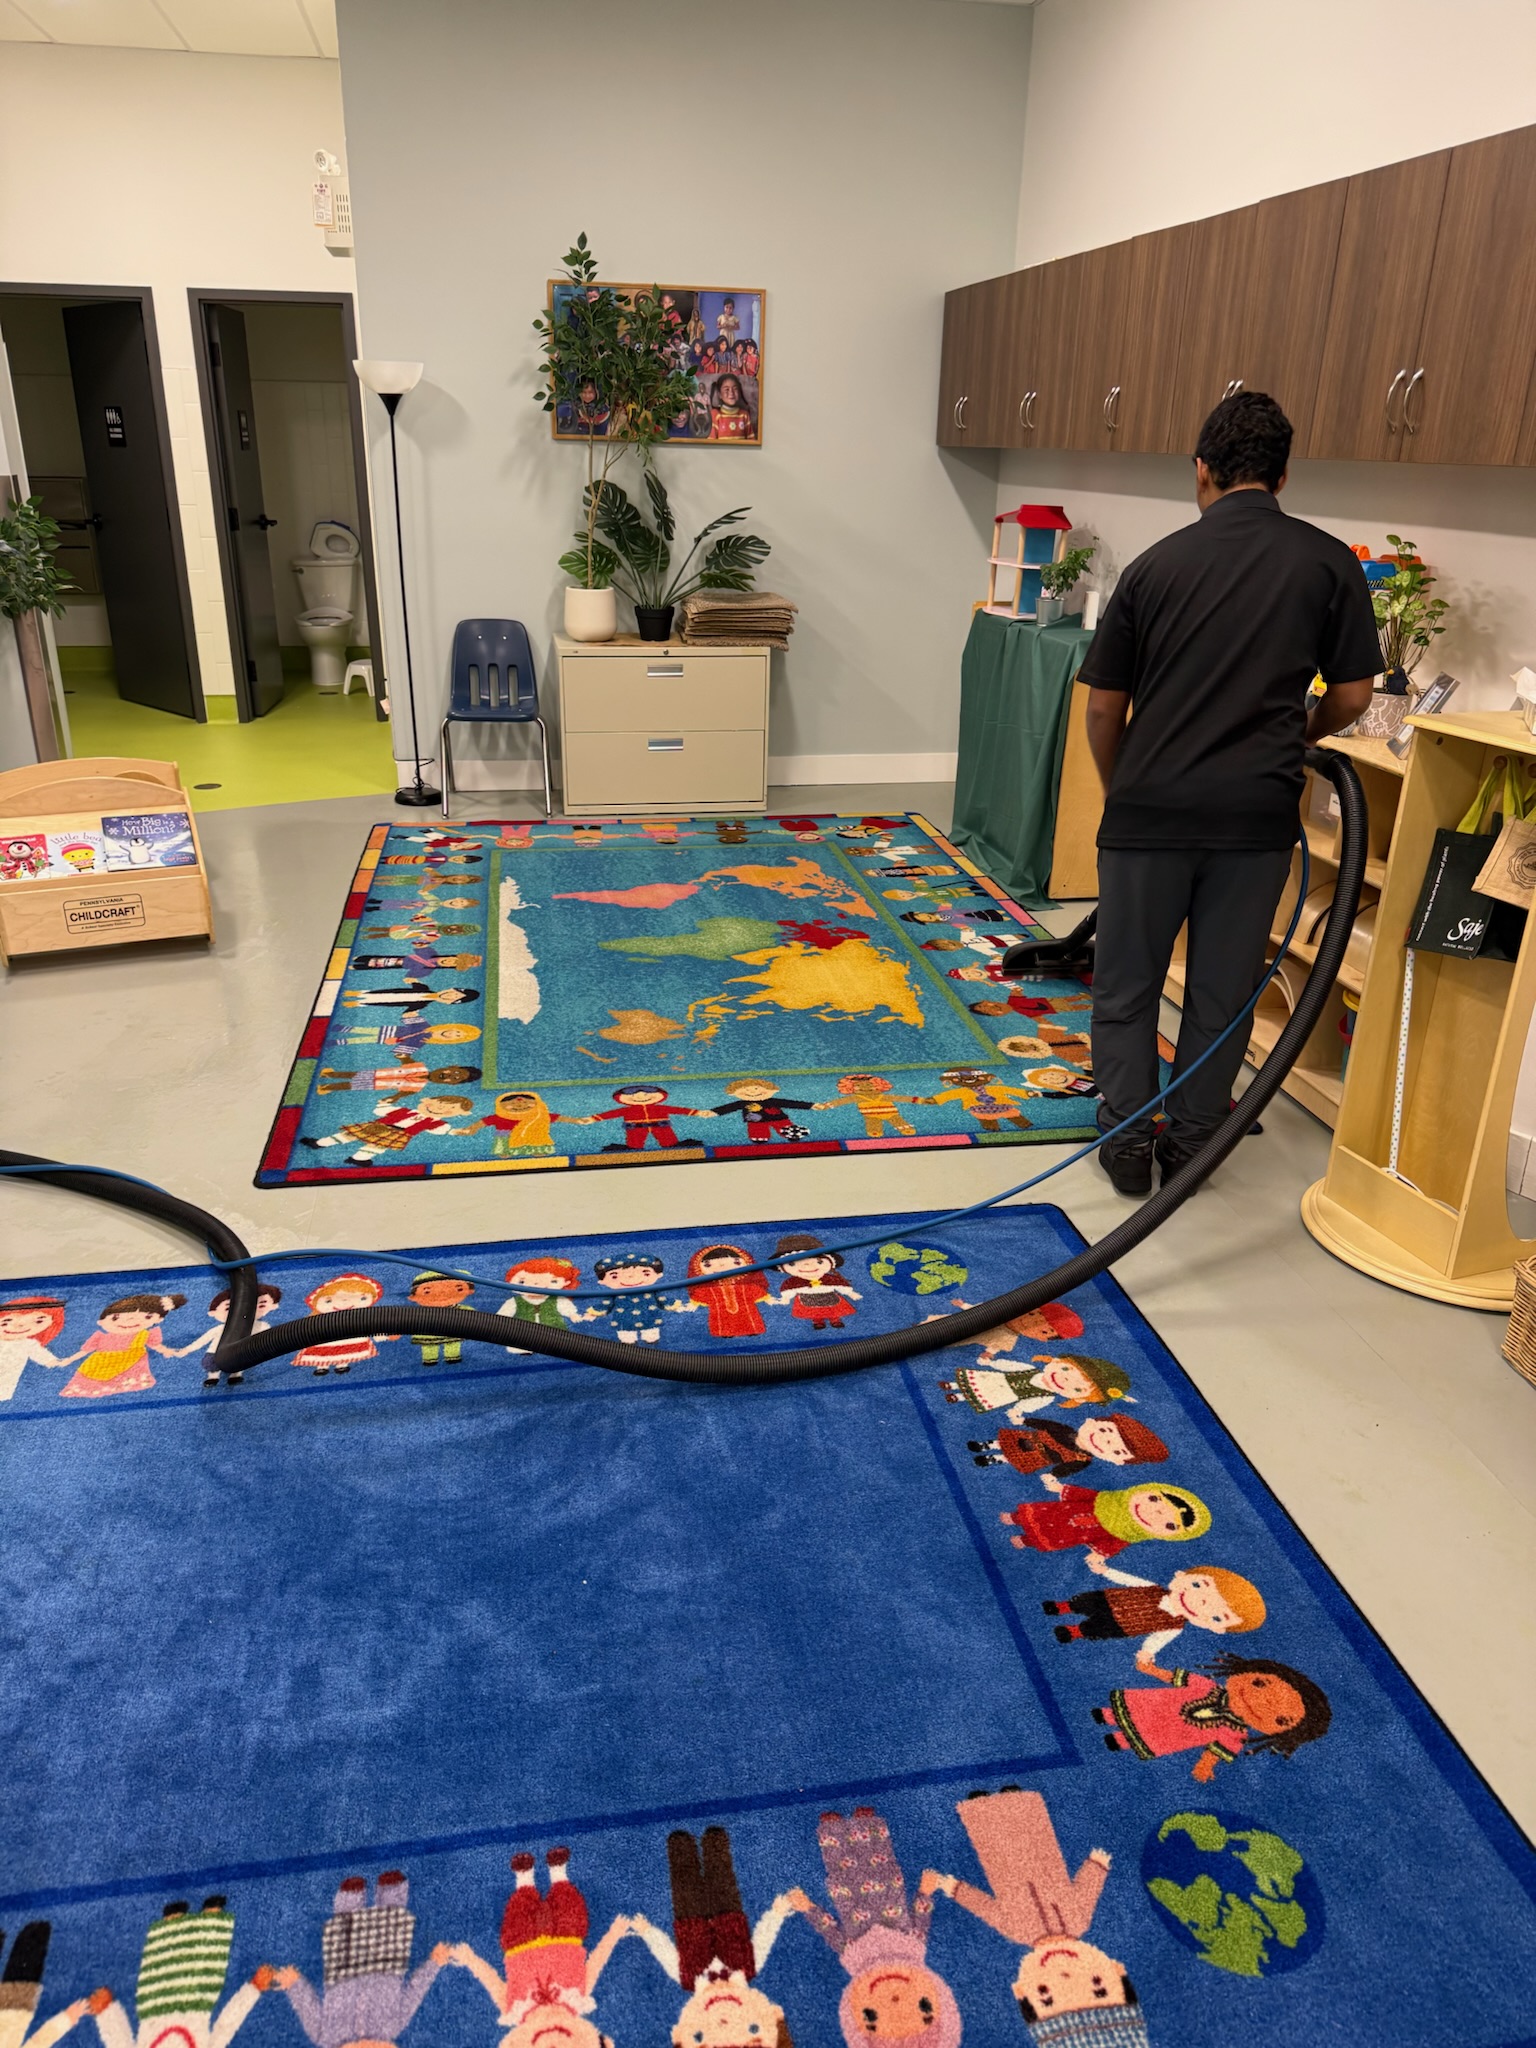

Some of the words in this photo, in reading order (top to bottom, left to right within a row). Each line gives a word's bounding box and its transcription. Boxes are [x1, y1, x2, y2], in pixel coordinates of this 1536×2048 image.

[141, 817, 161, 827] Big
[123, 824, 176, 836] Million?
[80, 898, 124, 906] PENNSYLVANIA
[70, 906, 136, 922] CHILDCRAFT
[1447, 917, 1484, 942] Saje
